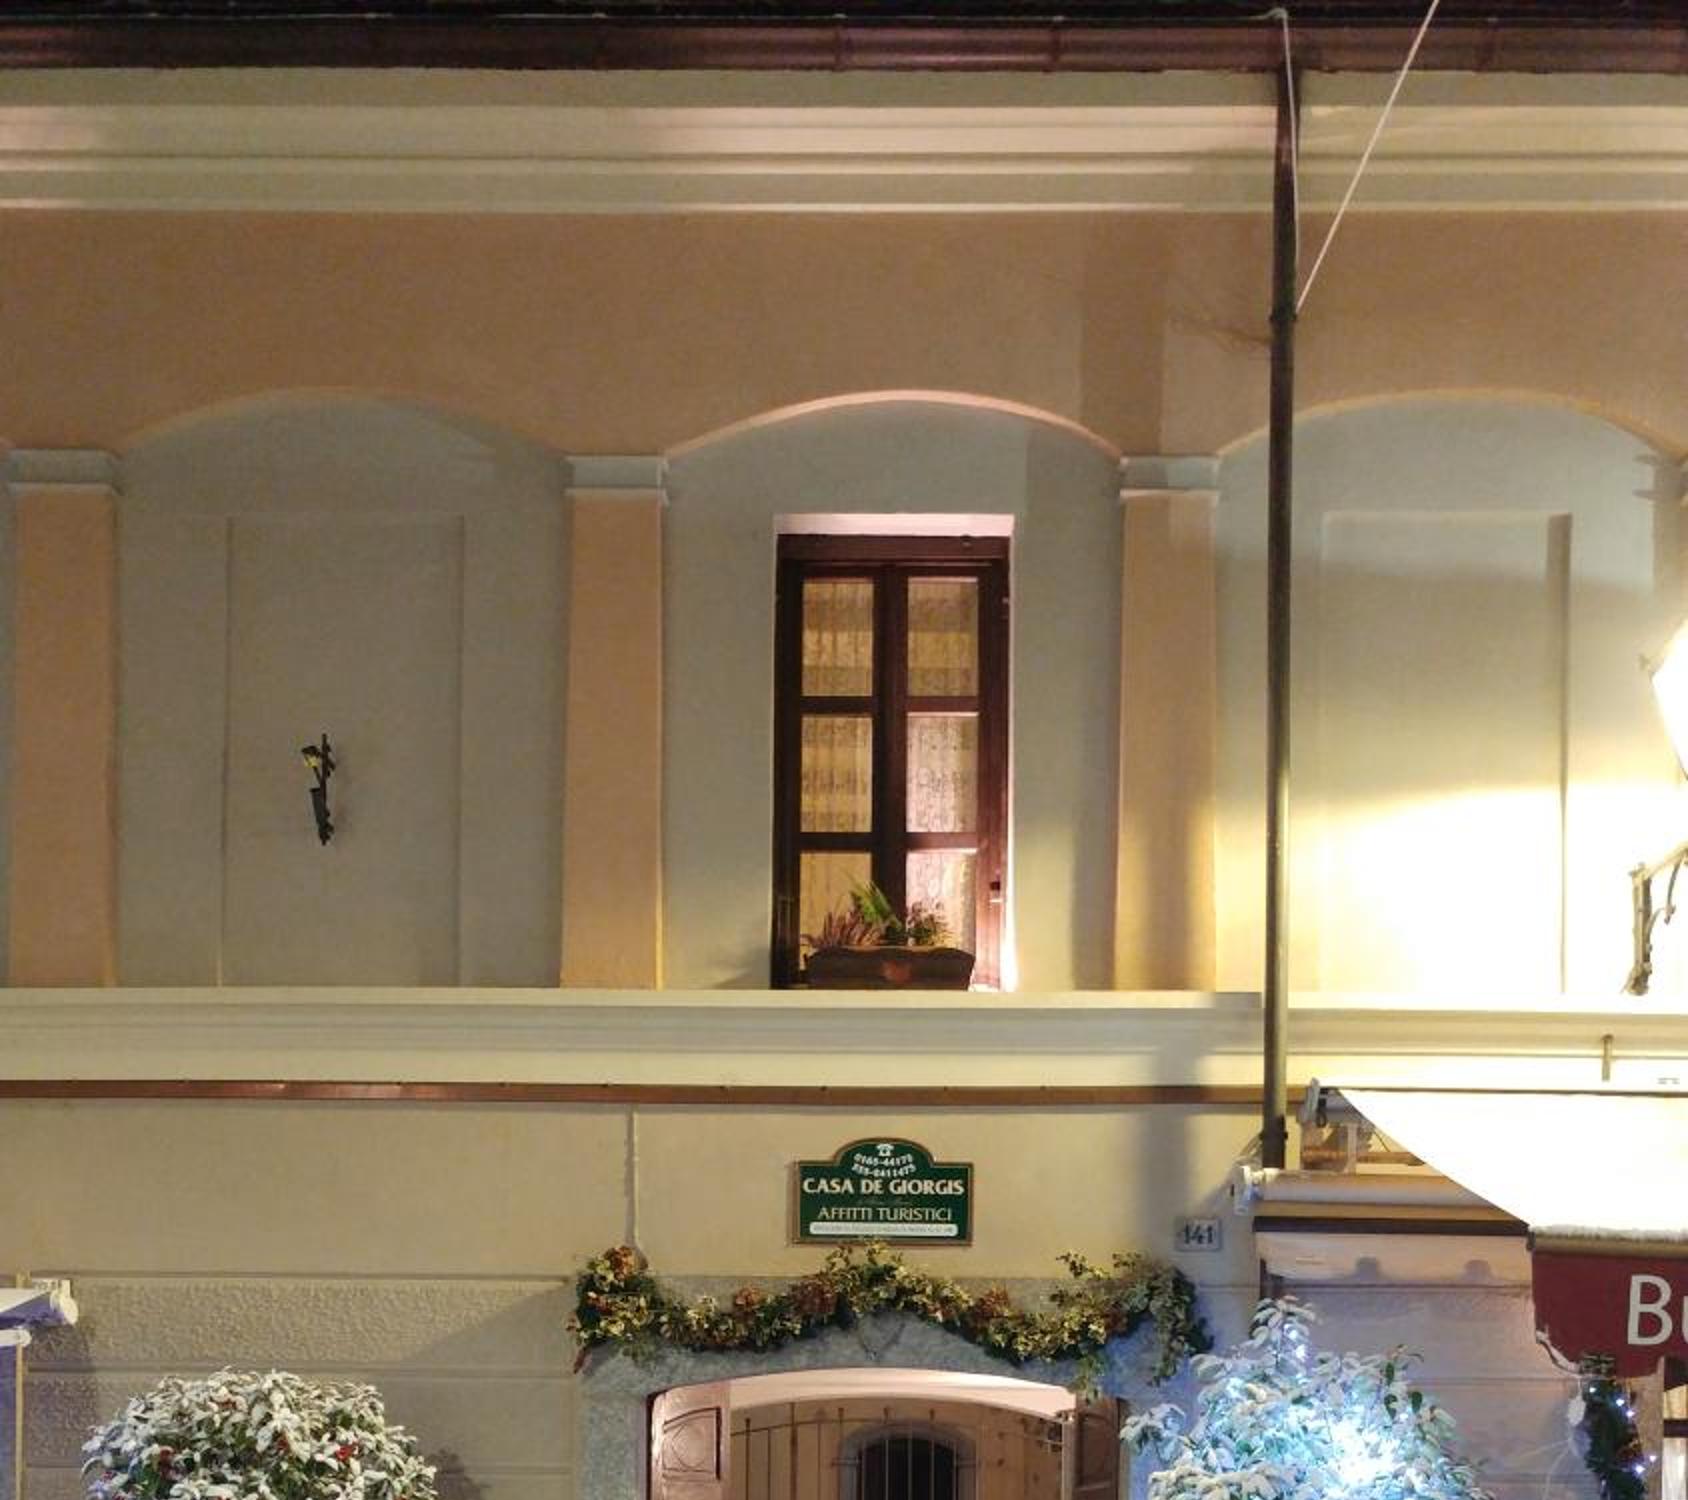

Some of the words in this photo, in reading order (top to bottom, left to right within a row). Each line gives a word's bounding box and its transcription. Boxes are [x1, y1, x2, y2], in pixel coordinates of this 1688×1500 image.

[803, 1178, 854, 1193] CASA
[861, 1179, 884, 1194] DE
[889, 1179, 965, 1195] GIORGIS
[817, 1207, 873, 1221] AFFITTI
[876, 1207, 952, 1222] TURISTICI
[1184, 1223, 1213, 1245] 141
[1627, 1274, 1688, 1345] B
